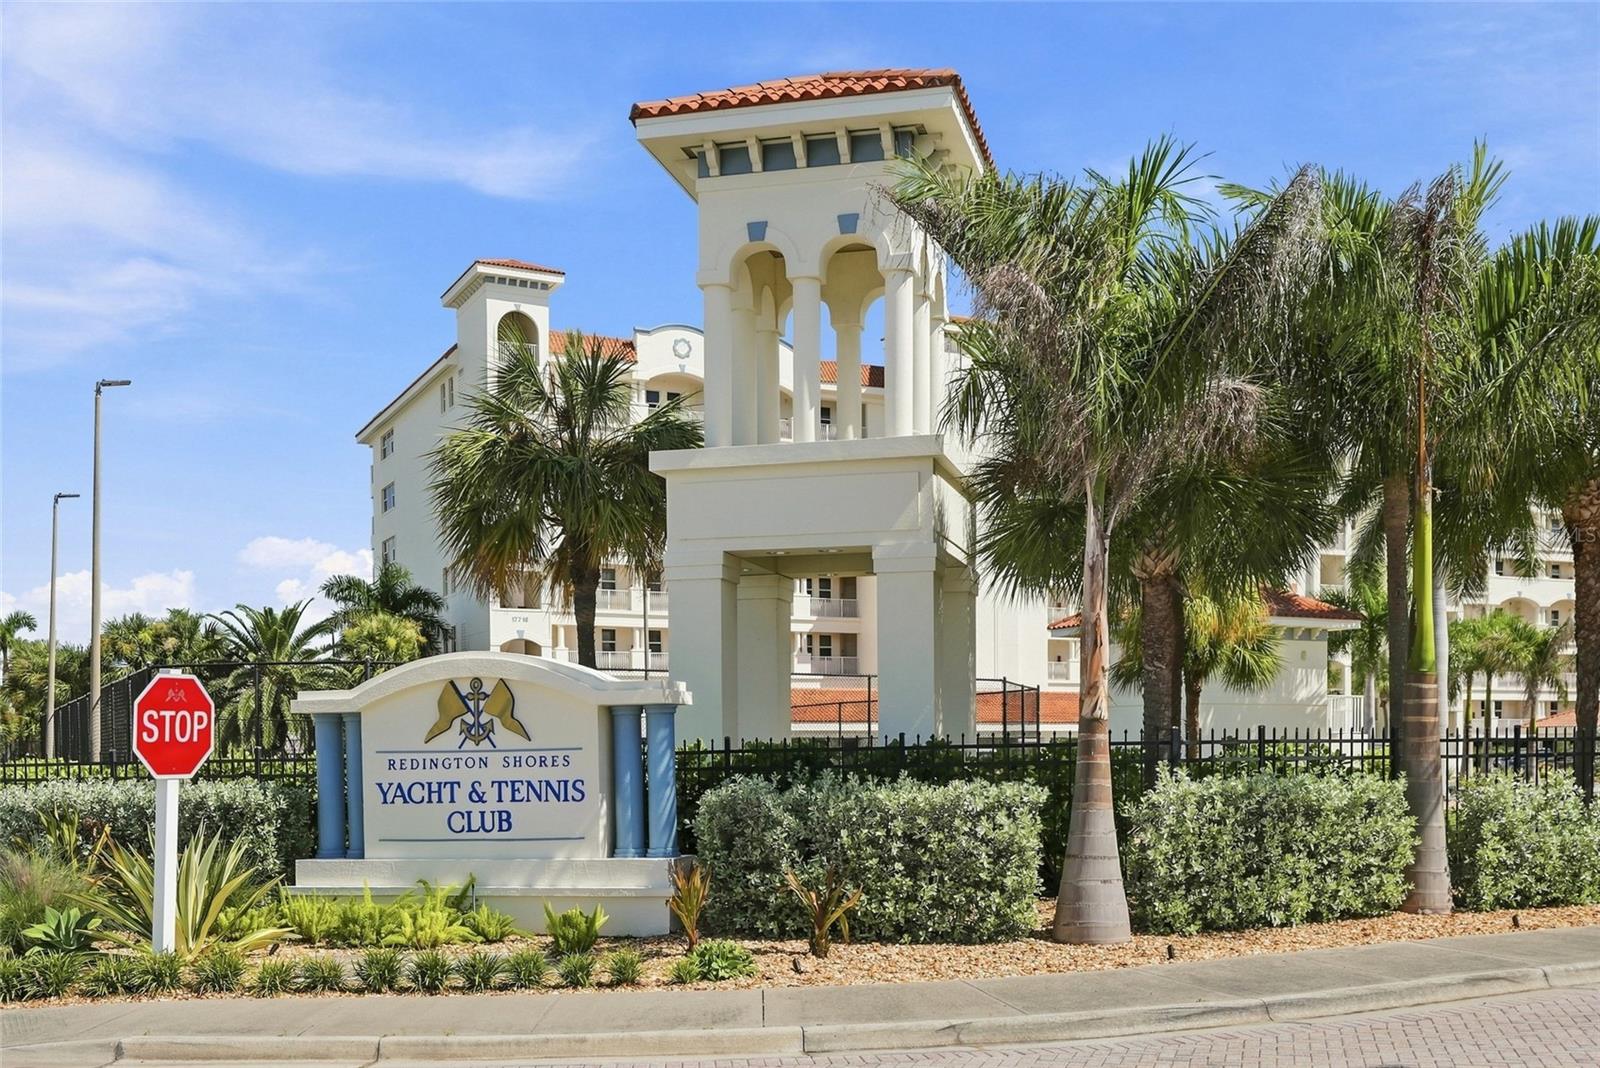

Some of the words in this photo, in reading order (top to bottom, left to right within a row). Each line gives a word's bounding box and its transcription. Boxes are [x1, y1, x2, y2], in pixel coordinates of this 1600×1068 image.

[142, 709, 208, 743] STOP
[387, 756, 489, 771] REDINGTON
[502, 755, 571, 768] SHORES
[375, 781, 461, 805] YACHT
[468, 780, 488, 804] &
[491, 779, 586, 803] TENNIS
[446, 810, 513, 834] CLUB
